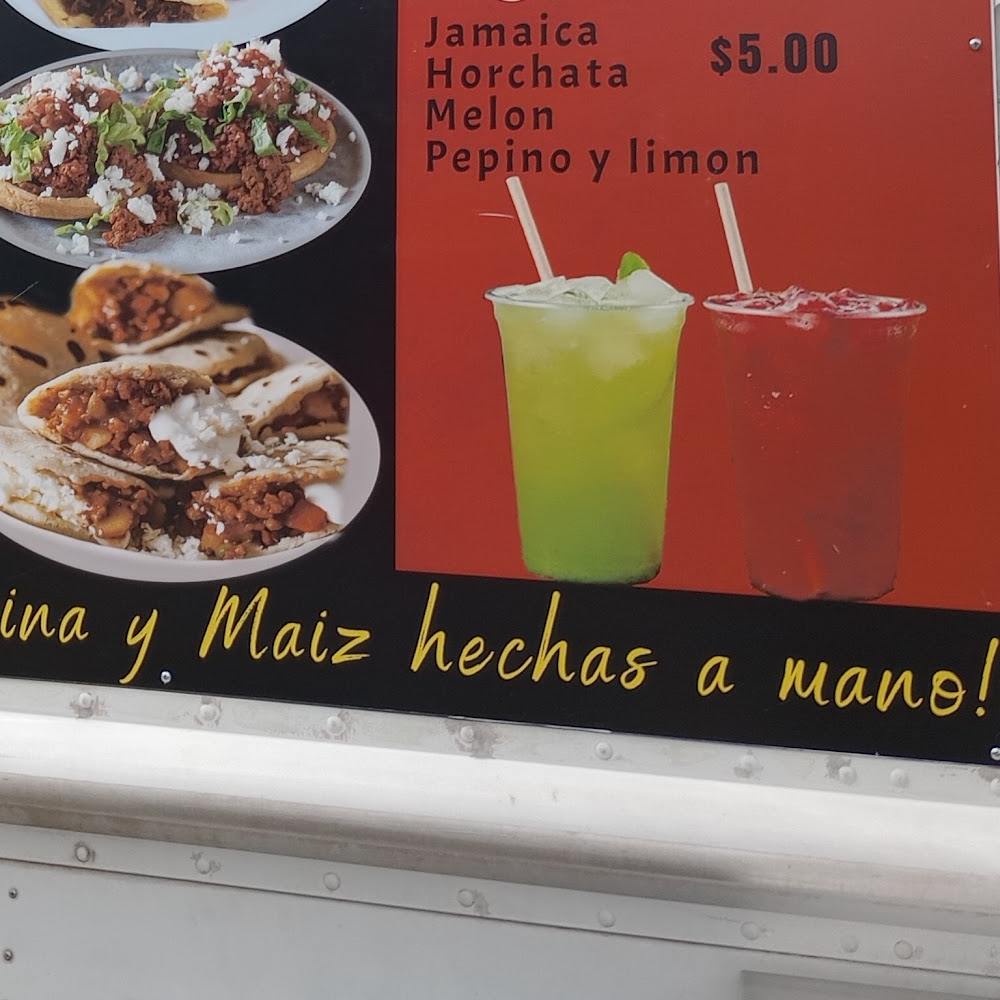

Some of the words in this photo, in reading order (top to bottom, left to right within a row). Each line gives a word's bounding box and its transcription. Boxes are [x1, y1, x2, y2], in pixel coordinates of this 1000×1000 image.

[424, 12, 599, 48] Jamaica
[426, 53, 630, 90] Horchata
[710, 32, 839, 77] $5.00
[425, 95, 554, 132] Melon
[425, 138, 572, 182] Pepino
[590, 147, 610, 184] y
[629, 136, 760, 177] limon
[119, 608, 160, 684] y
[198, 584, 373, 665] Maiz
[410, 582, 660, 691] hechas
[696, 654, 735, 698] a
[778, 637, 999, 718] mano!
